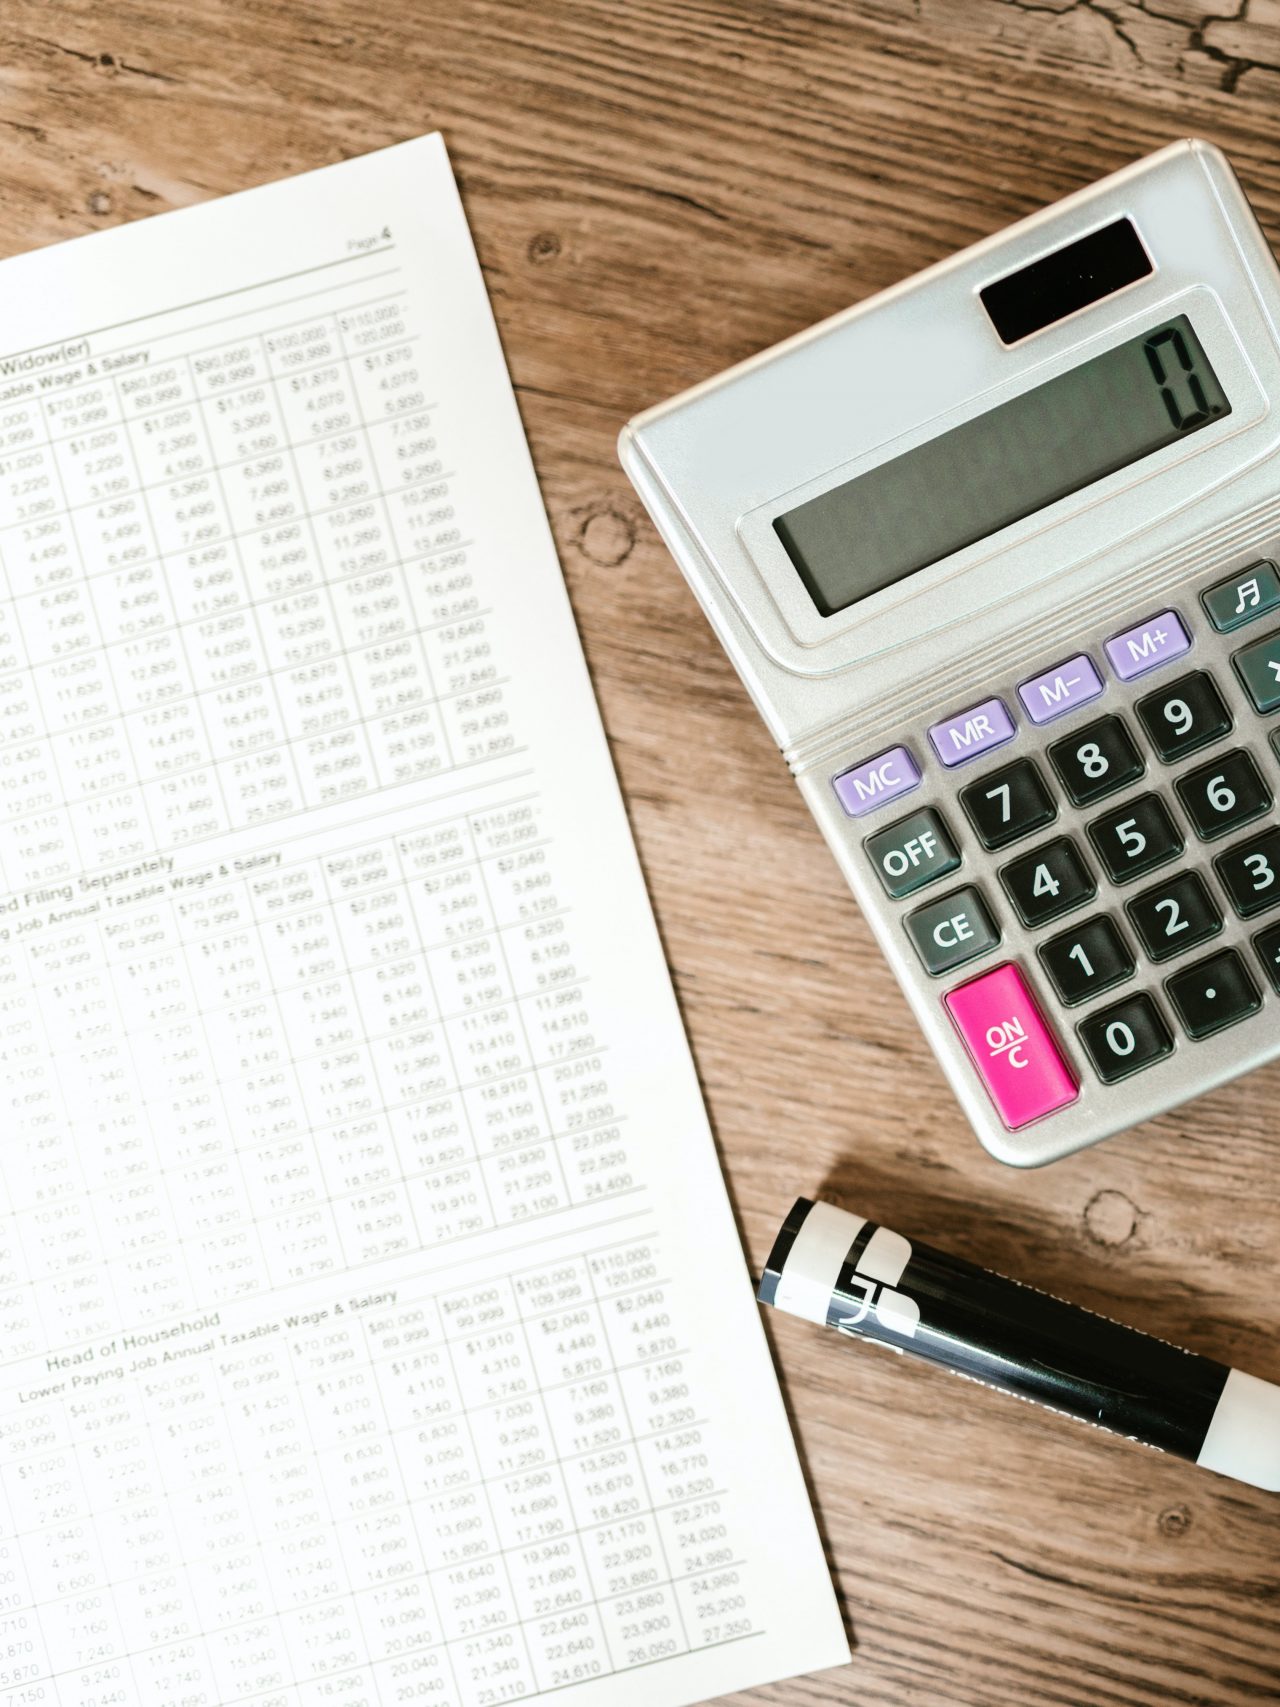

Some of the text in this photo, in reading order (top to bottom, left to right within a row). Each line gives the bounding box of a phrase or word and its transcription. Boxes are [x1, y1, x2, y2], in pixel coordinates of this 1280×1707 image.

[0, 339, 90, 375] Widow(er)
[1127, 630, 1167, 661] M+
[949, 715, 994, 749] MR
[1164, 700, 1192, 735] 9
[1077, 744, 1108, 777] 8
[853, 762, 900, 800] MC
[1207, 776, 1235, 811] 6
[986, 784, 1010, 822] 7
[883, 831, 937, 878] OFF
[1116, 819, 1146, 857] 5
[1034, 864, 1059, 896] 4
[1244, 854, 1274, 890] 3
[934, 914, 974, 947] CE
[1155, 899, 1189, 935] 2
[1070, 944, 1094, 976] 1
[1106, 1022, 1134, 1055] 0
